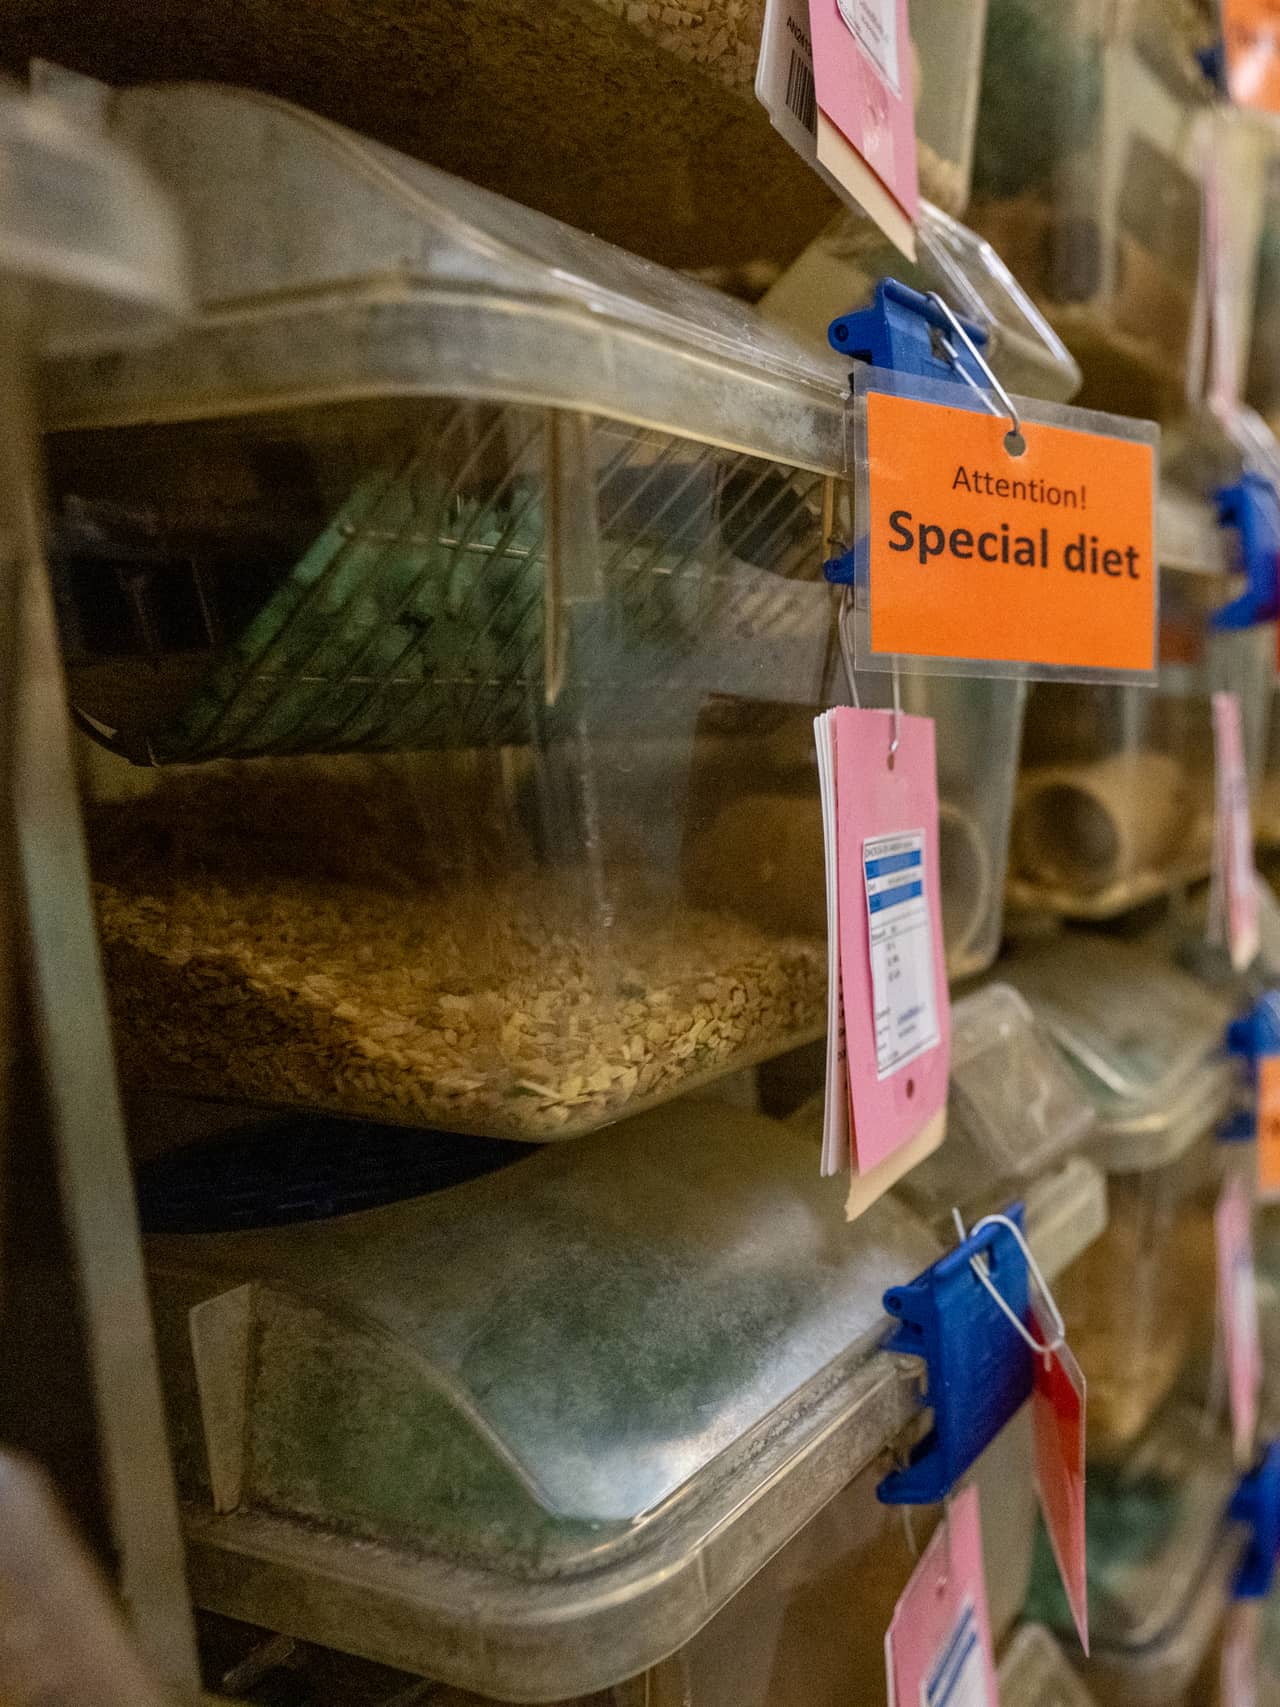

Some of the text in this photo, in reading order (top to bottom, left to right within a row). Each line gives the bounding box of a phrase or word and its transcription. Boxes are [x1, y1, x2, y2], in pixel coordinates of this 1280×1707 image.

[952, 465, 1086, 509] Attention!
[888, 510, 1140, 580] Special diet
